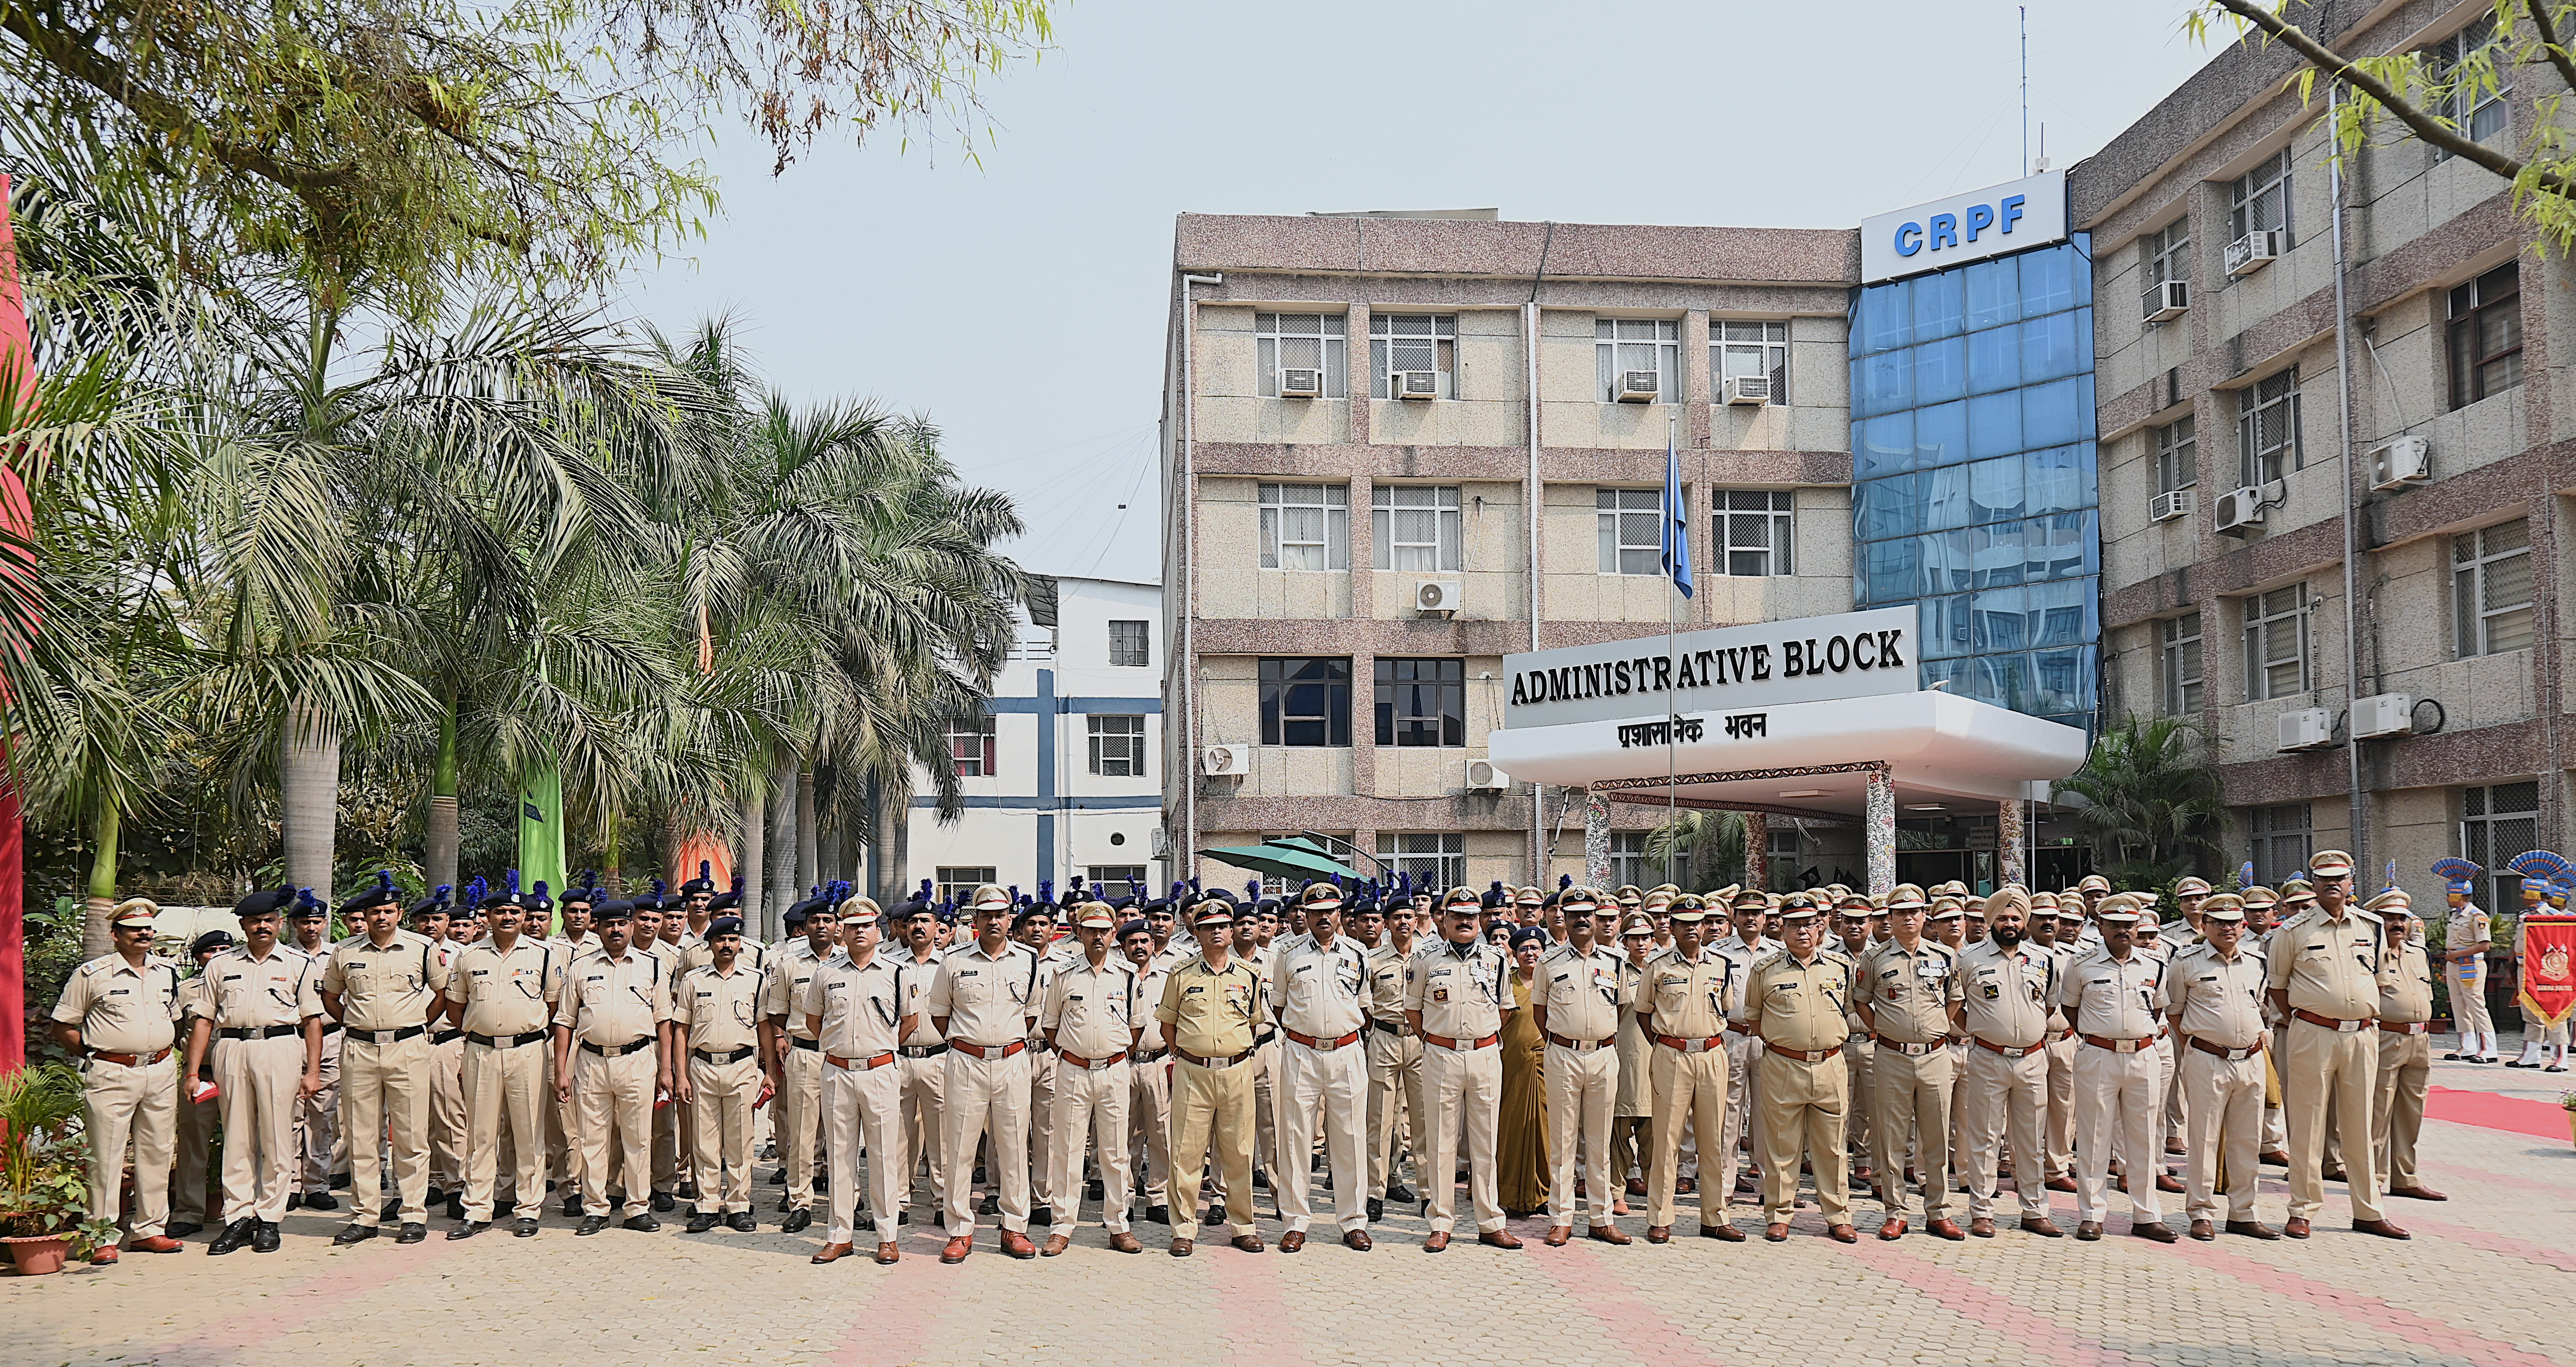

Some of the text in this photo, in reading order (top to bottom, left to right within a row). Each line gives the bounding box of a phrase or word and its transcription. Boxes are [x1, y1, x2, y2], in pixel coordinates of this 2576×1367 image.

[1895, 193, 2025, 256] CRPF
[1511, 629, 1905, 707] ADMINISTRATIVE BLOCK
[1725, 713, 1767, 740] भवन
